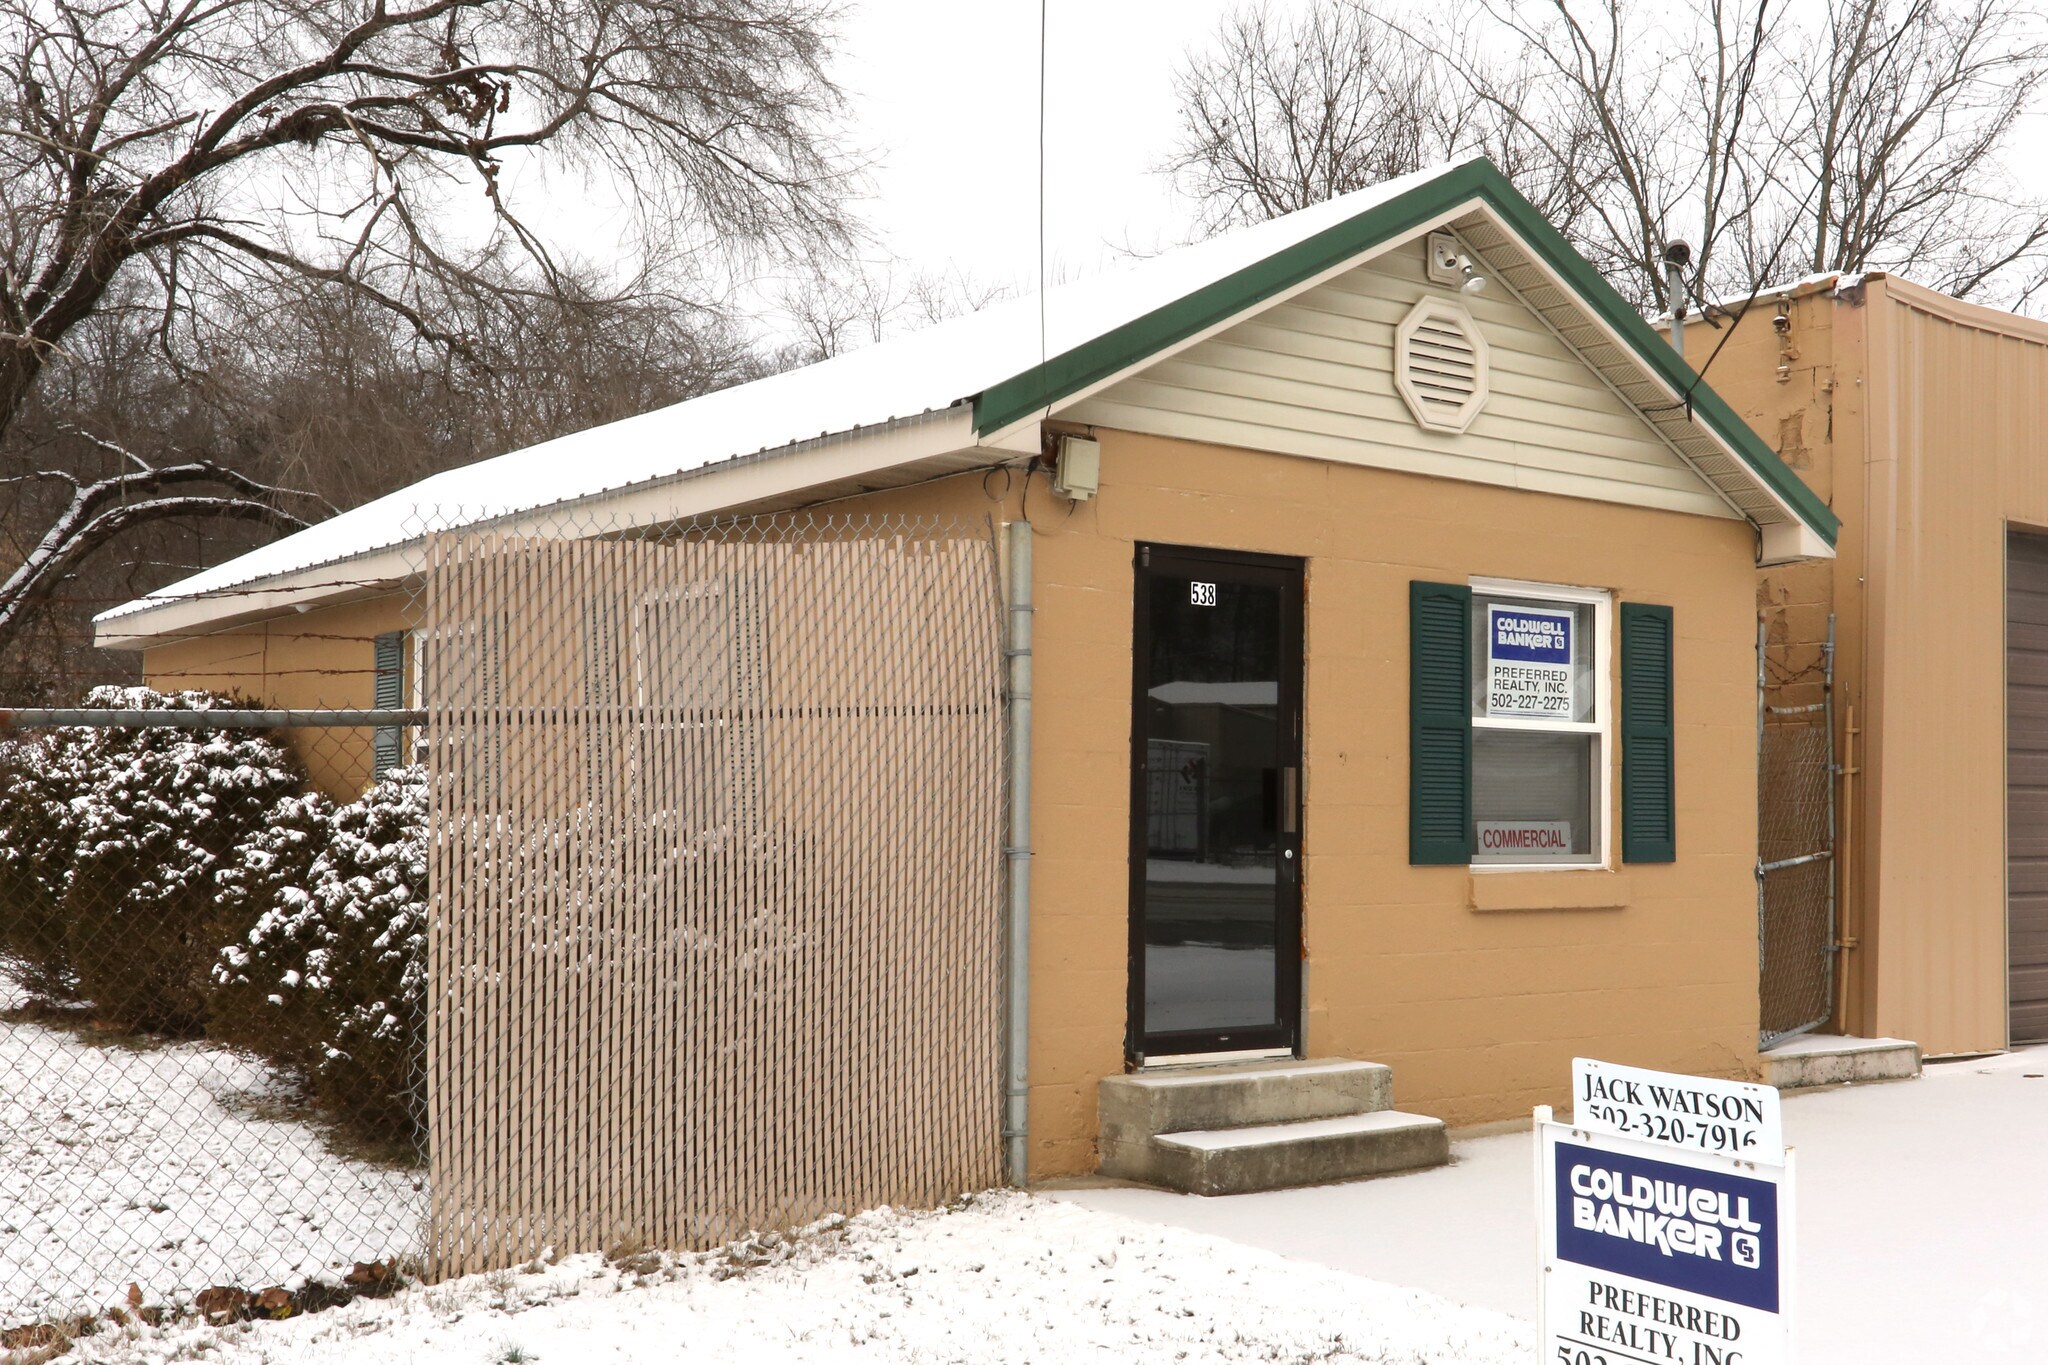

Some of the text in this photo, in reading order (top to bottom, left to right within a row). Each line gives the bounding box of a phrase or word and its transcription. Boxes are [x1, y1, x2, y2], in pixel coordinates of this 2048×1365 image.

[1192, 583, 1214, 604] 538
[1497, 617, 1564, 636] COLDWELL
[1498, 631, 1553, 649] BANKER
[1494, 666, 1568, 682] PREFERRED
[1494, 678, 1568, 694] REALTY, INC.
[1491, 693, 1570, 711] 502-227-2275
[1483, 829, 1566, 848] COMMERCIAL
[1582, 1073, 1764, 1125] JACK WATSON
[1570, 1163, 1762, 1234] COLDWELL
[1573, 1195, 1724, 1262] BANKER
[1589, 1280, 1742, 1343] PREFERRED
[1579, 1310, 1685, 1364] REALTY,
